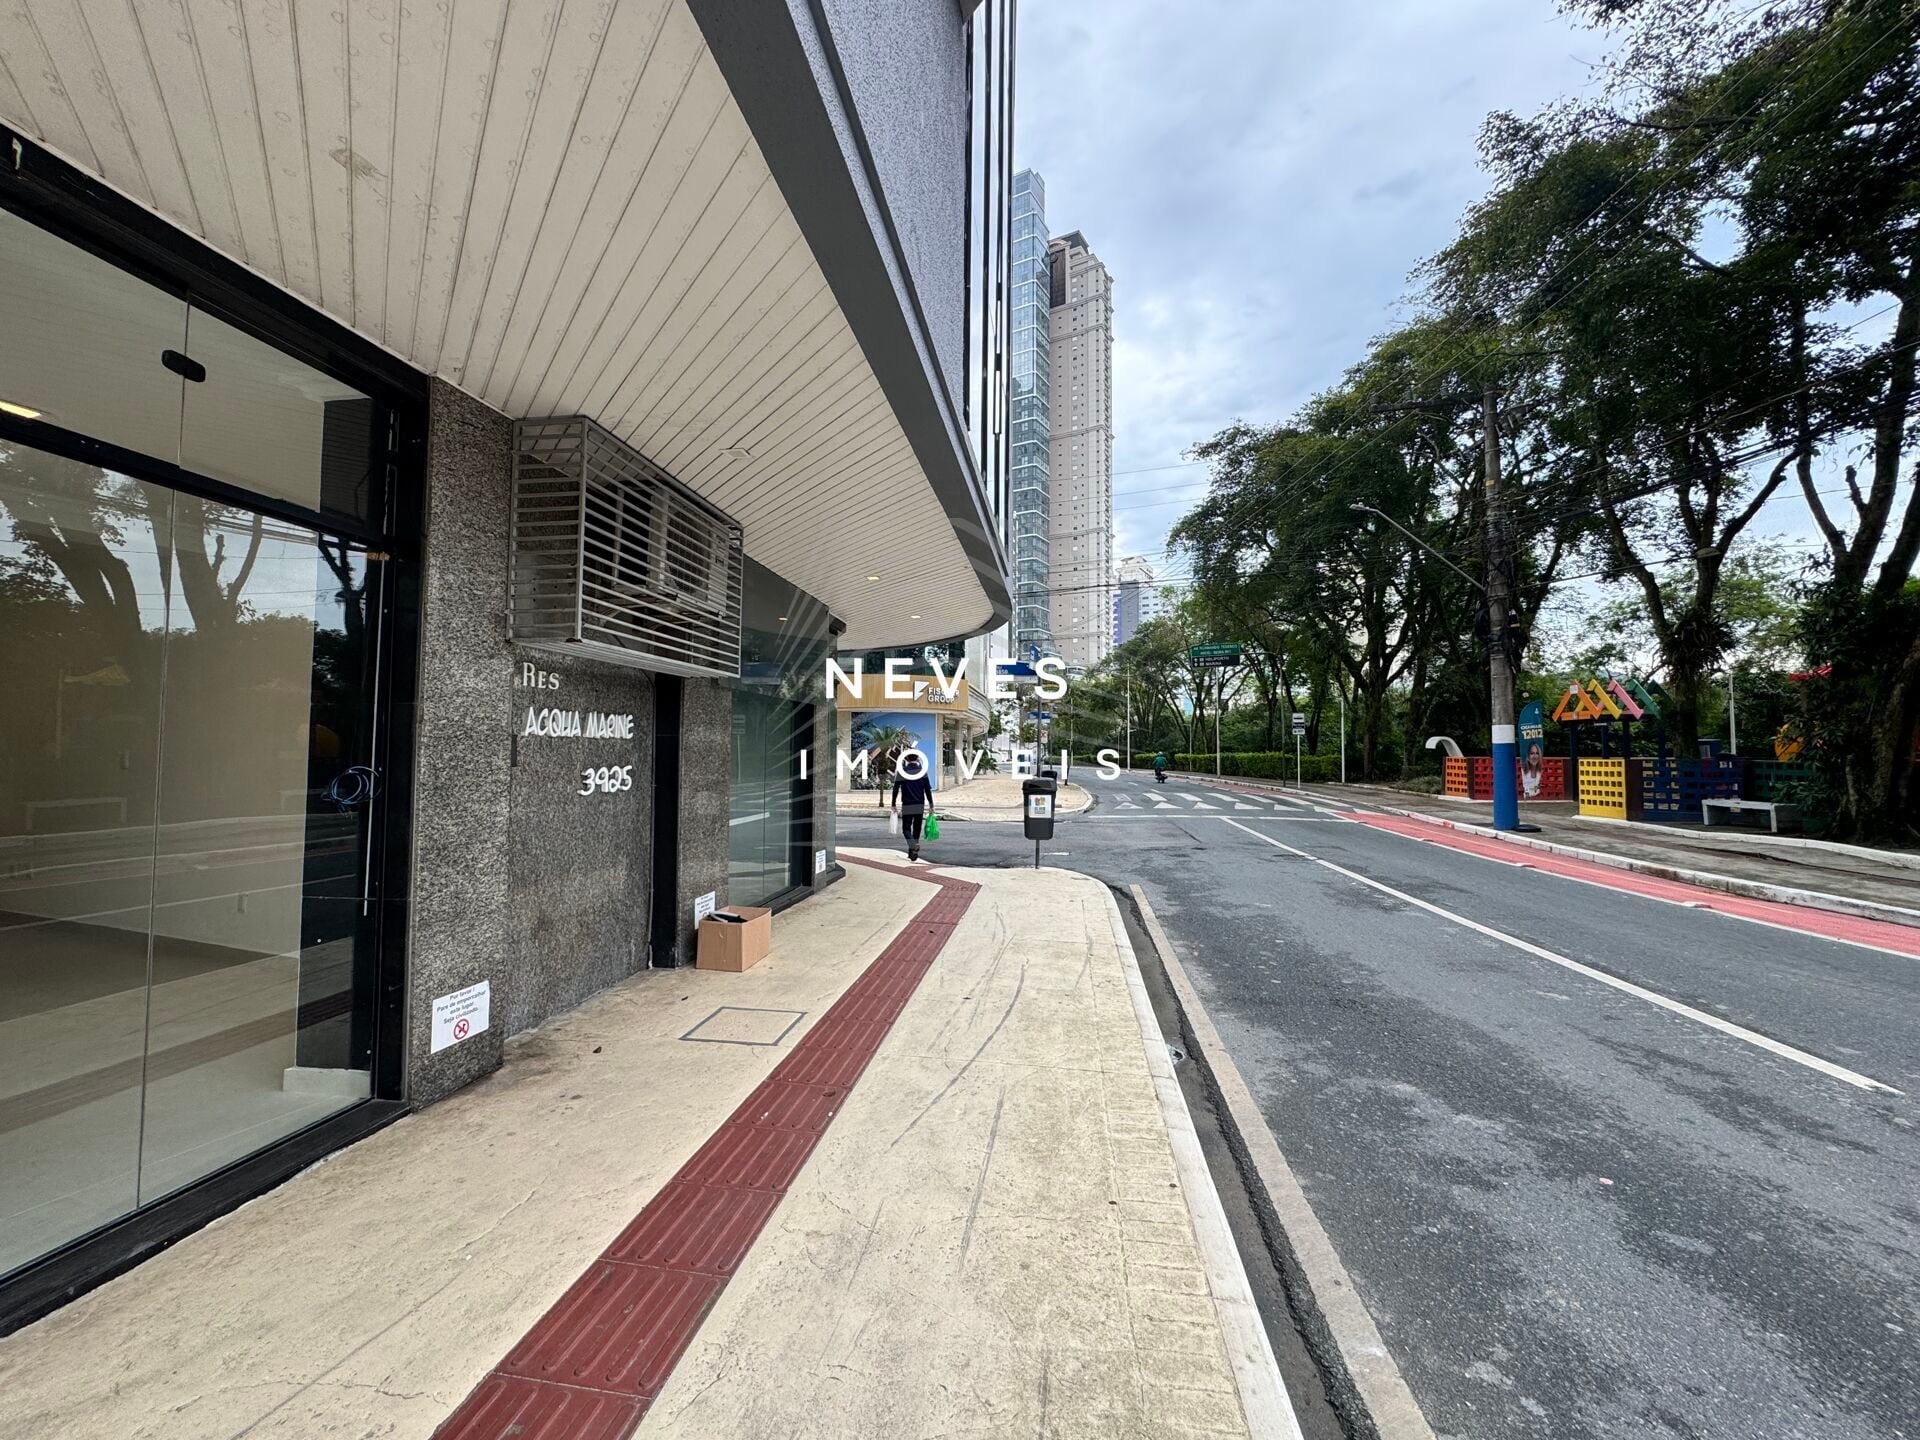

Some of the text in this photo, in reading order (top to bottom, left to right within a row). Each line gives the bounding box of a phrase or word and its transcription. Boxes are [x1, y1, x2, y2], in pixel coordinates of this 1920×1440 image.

[523, 706, 634, 739] ACQUA MARINE
[577, 765, 632, 796] 3925
